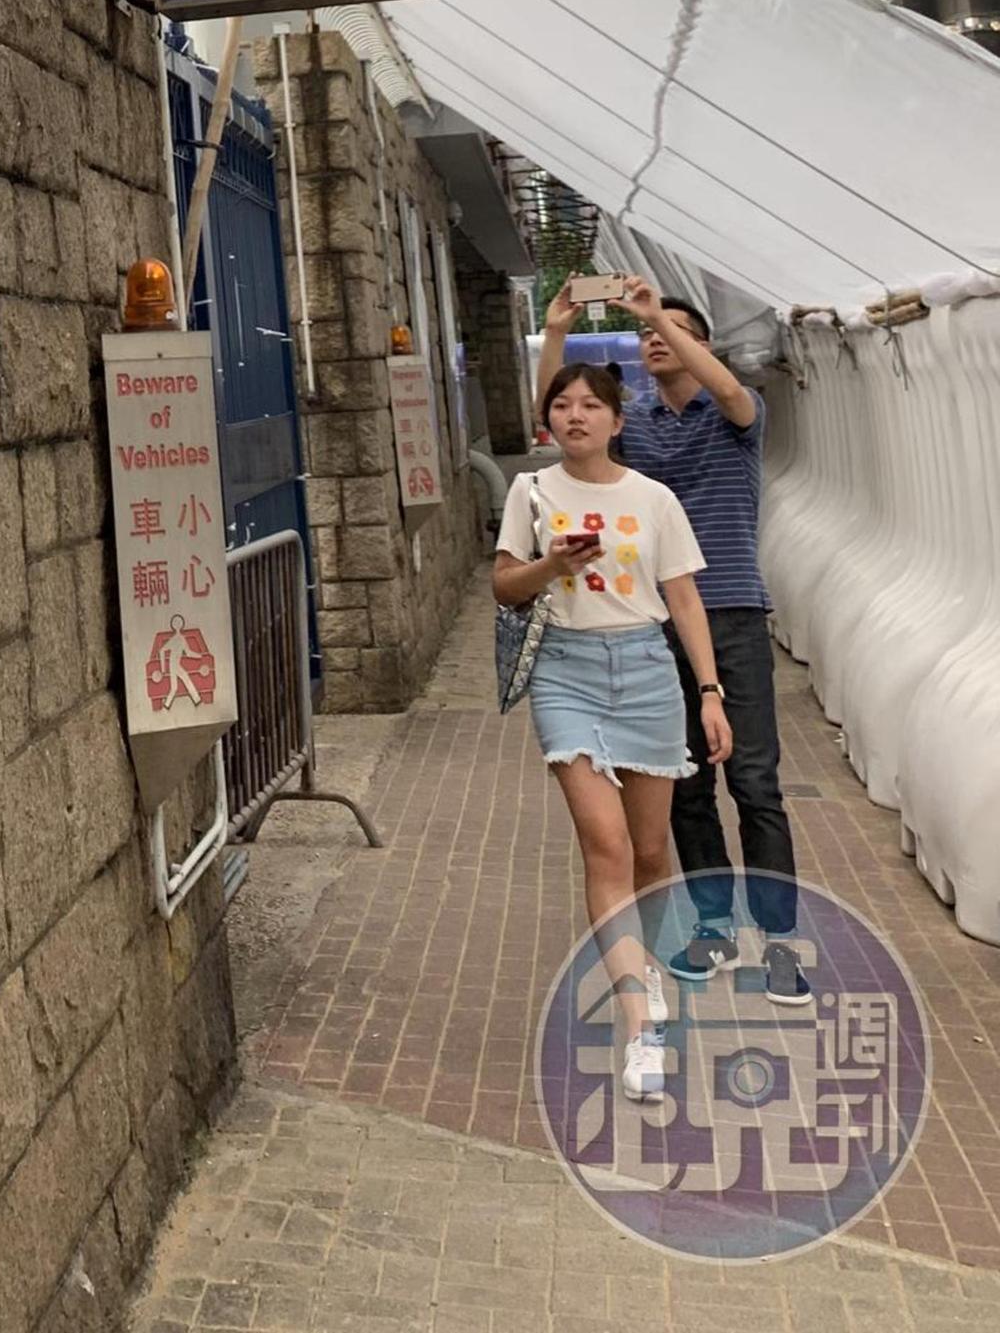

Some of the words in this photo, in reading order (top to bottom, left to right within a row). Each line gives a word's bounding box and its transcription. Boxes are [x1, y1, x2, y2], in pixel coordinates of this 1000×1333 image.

[116, 373, 198, 396] Beware
[149, 406, 171, 429] of
[118, 443, 210, 470] Vehicles
